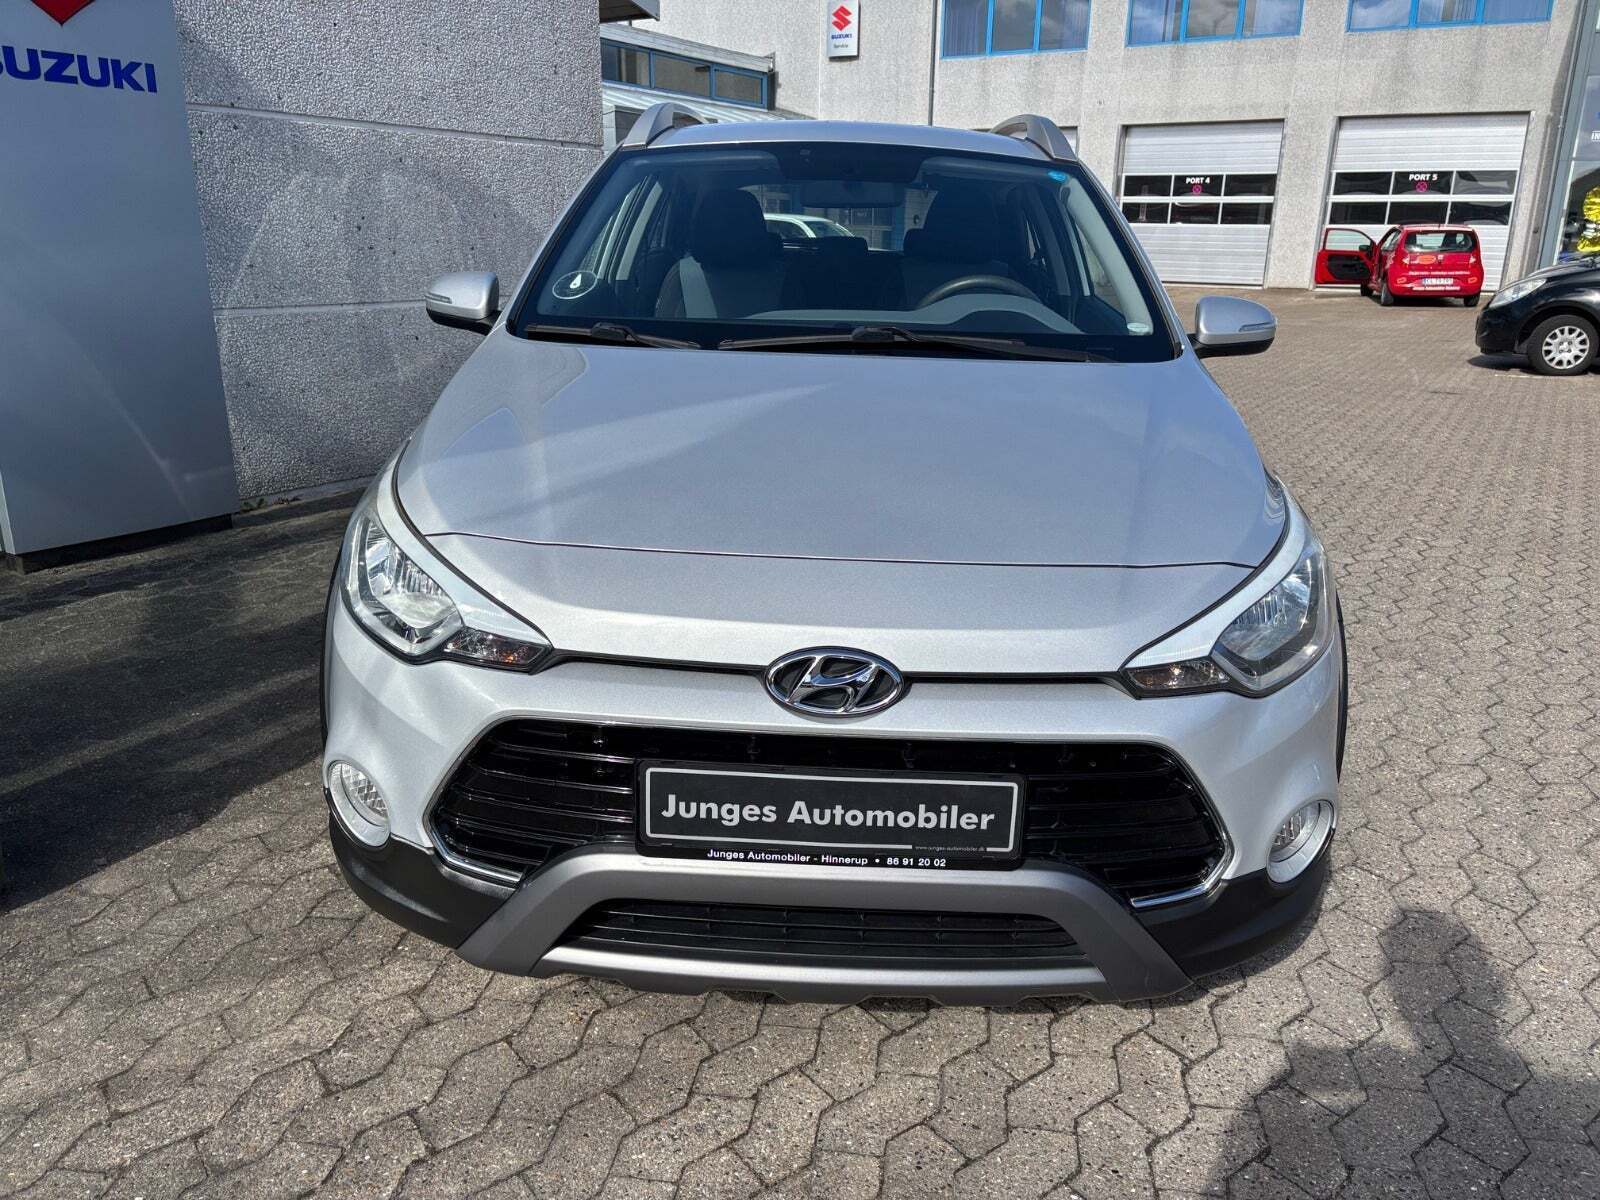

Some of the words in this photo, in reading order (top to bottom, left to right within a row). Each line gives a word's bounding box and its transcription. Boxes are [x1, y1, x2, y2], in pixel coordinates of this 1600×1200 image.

[0, 45, 158, 93] UZUKI
[1408, 173, 1431, 181] PORT
[1432, 173, 1438, 181] 5
[661, 794, 777, 827] Junges
[787, 800, 995, 830] Automobiler
[707, 849, 745, 860] Junges
[747, 850, 811, 863] Automobiler
[821, 855, 868, 865] Hinnerup
[886, 857, 899, 866] 86
[902, 858, 914, 867] 91
[918, 858, 931, 867] 20
[933, 858, 946, 867] 02
